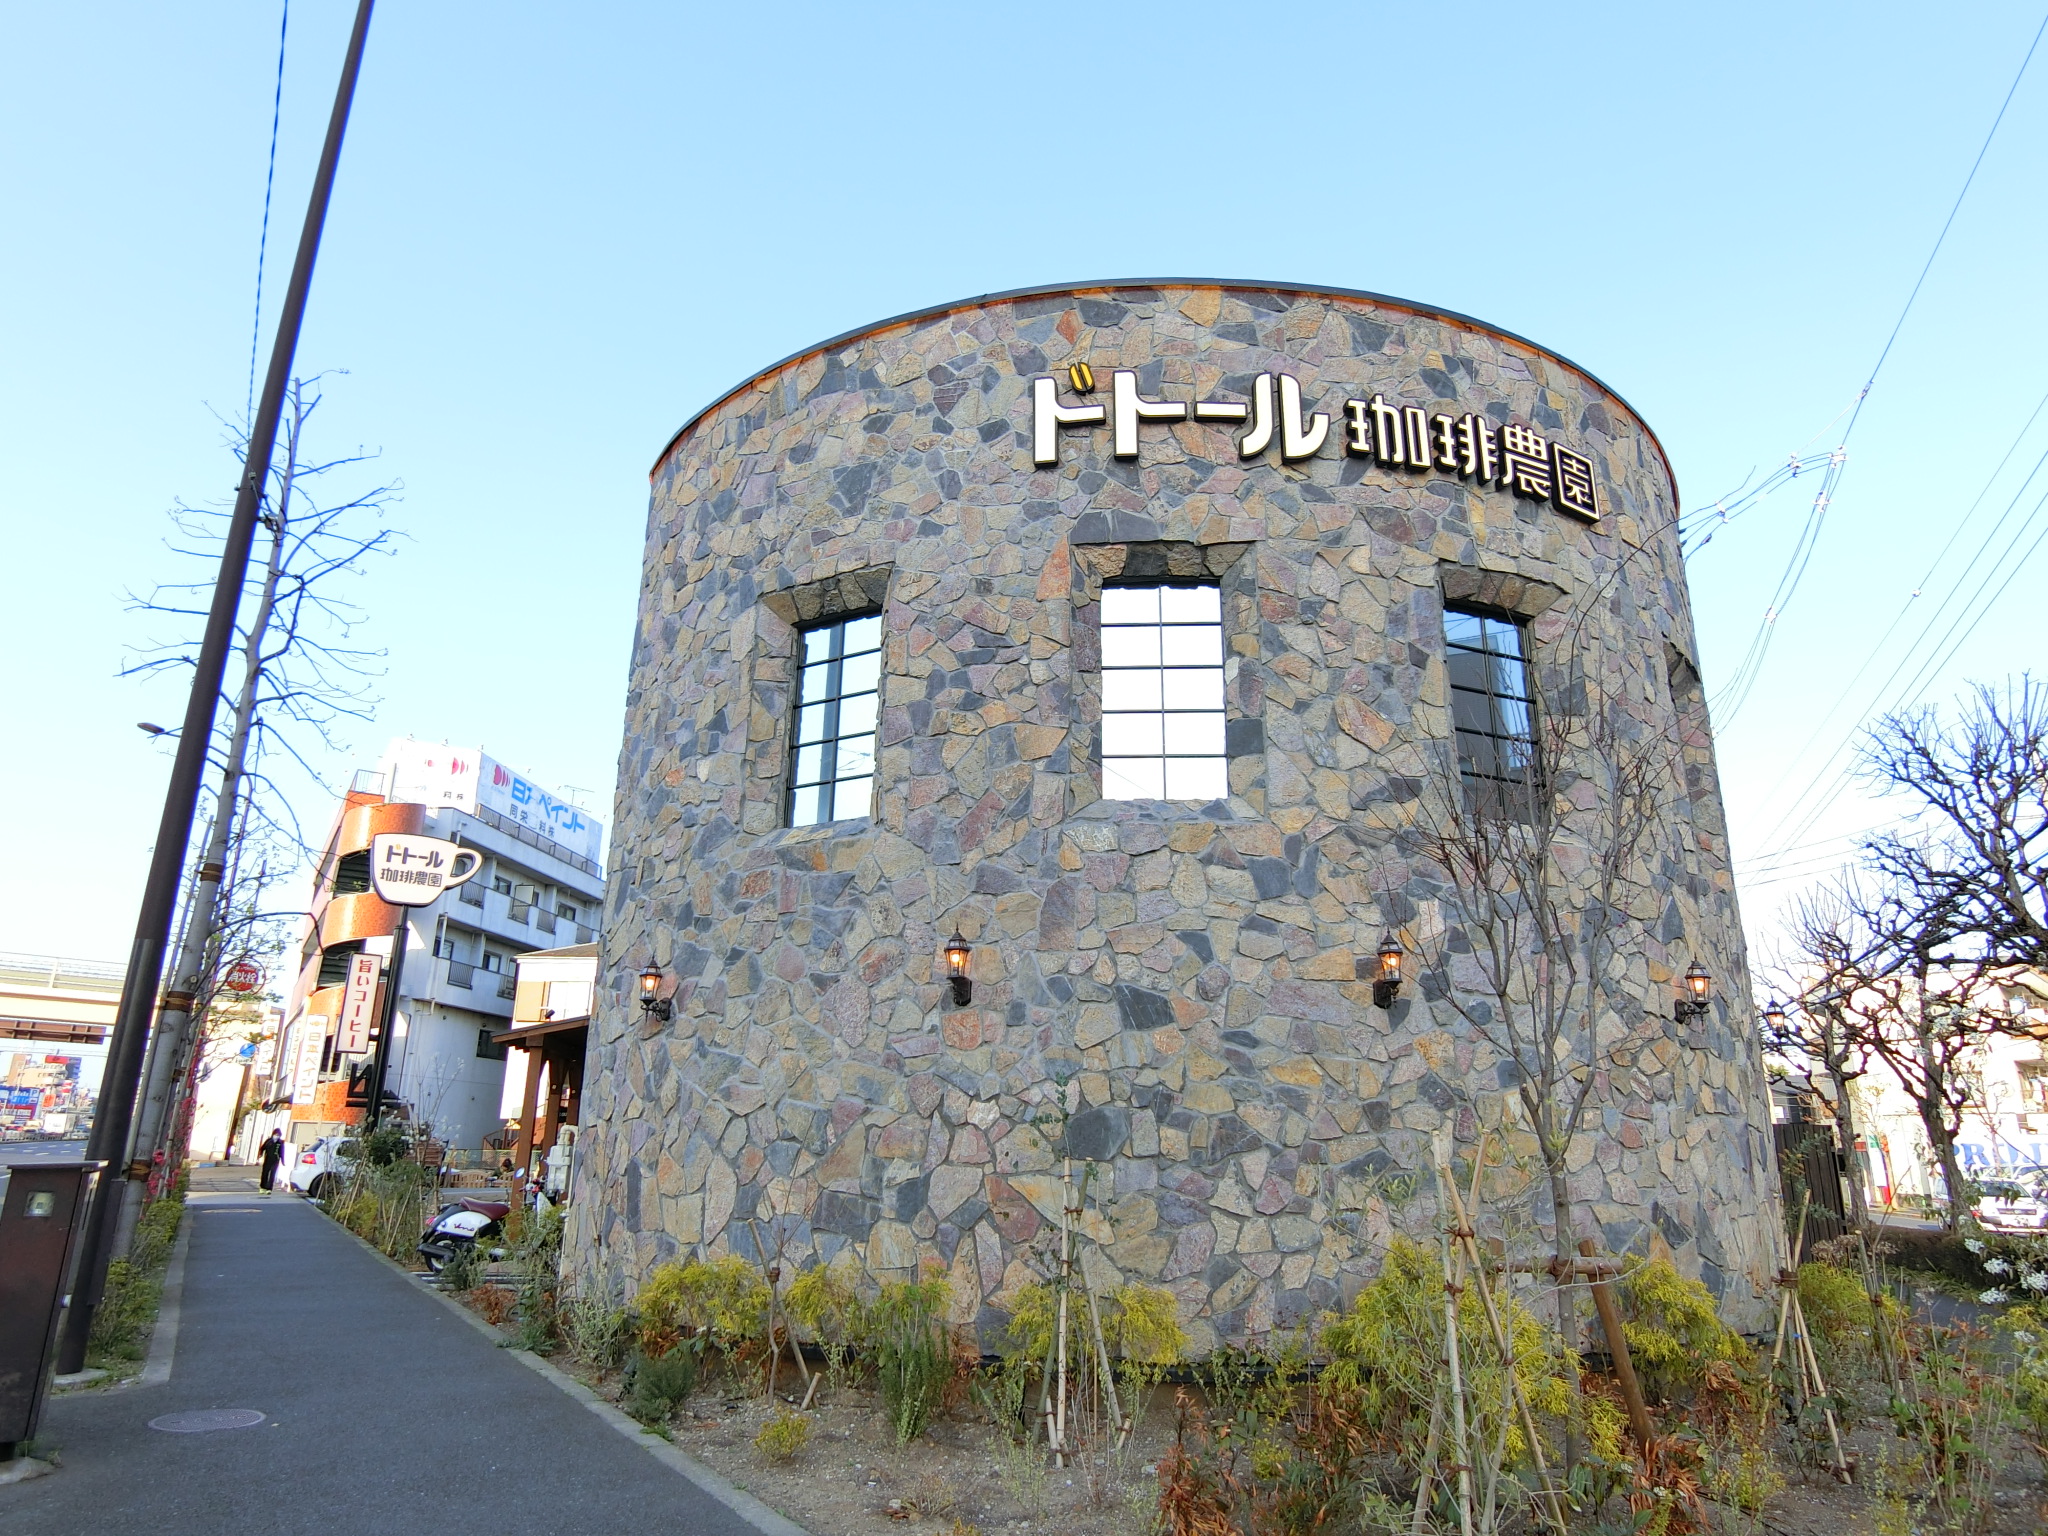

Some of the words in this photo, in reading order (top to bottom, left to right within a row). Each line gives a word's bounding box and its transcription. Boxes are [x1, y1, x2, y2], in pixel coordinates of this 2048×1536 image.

[1033, 361, 1331, 468] ドトール
[1346, 393, 1601, 523] 珈琲農園
[380, 867, 442, 887] 珈琲農園
[386, 844, 444, 868] ドトール
[350, 959, 373, 1048] 旨いコーヒー
[299, 1032, 321, 1099] 日本ペイント
